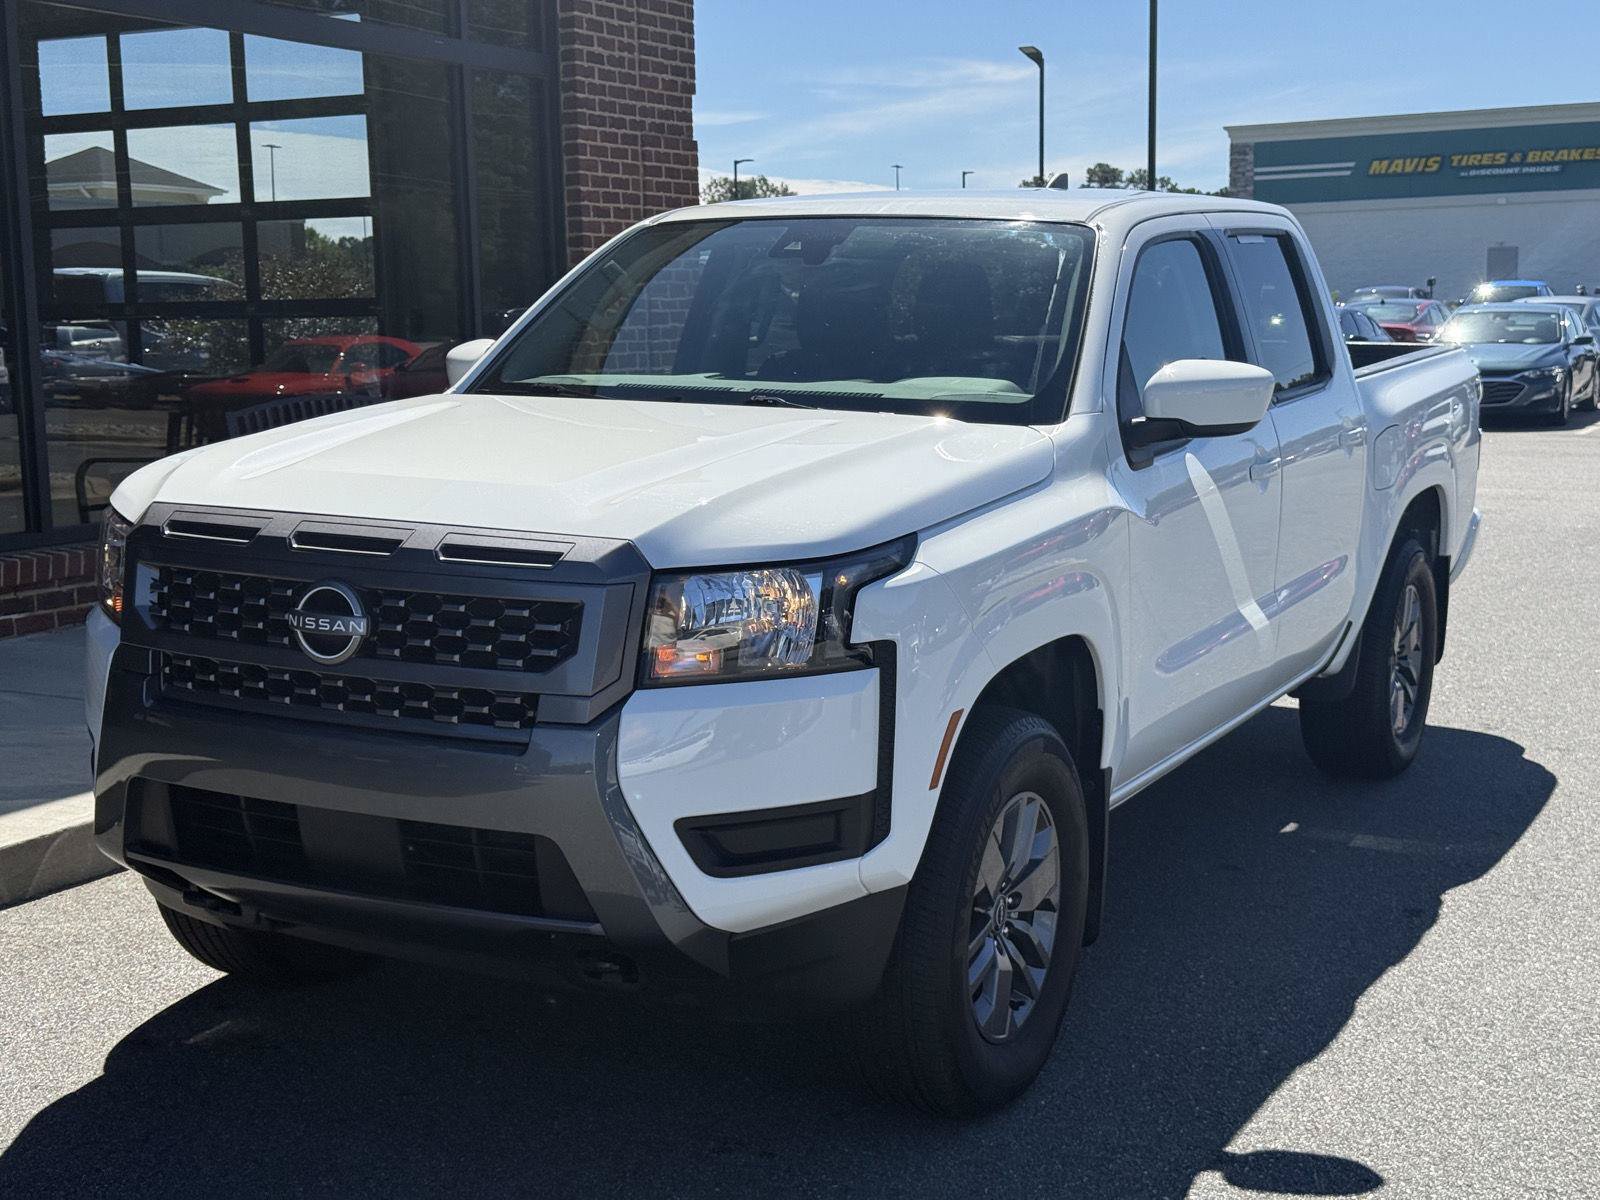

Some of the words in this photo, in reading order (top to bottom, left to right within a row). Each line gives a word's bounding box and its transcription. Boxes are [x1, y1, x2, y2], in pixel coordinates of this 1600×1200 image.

[1368, 156, 1441, 175] MAVIS
[1451, 152, 1507, 167] TIRES
[1511, 153, 1523, 163] &
[1469, 167, 1520, 176] DISCOUNT
[1522, 165, 1560, 174] PRICES
[289, 613, 364, 633] NISSAN
